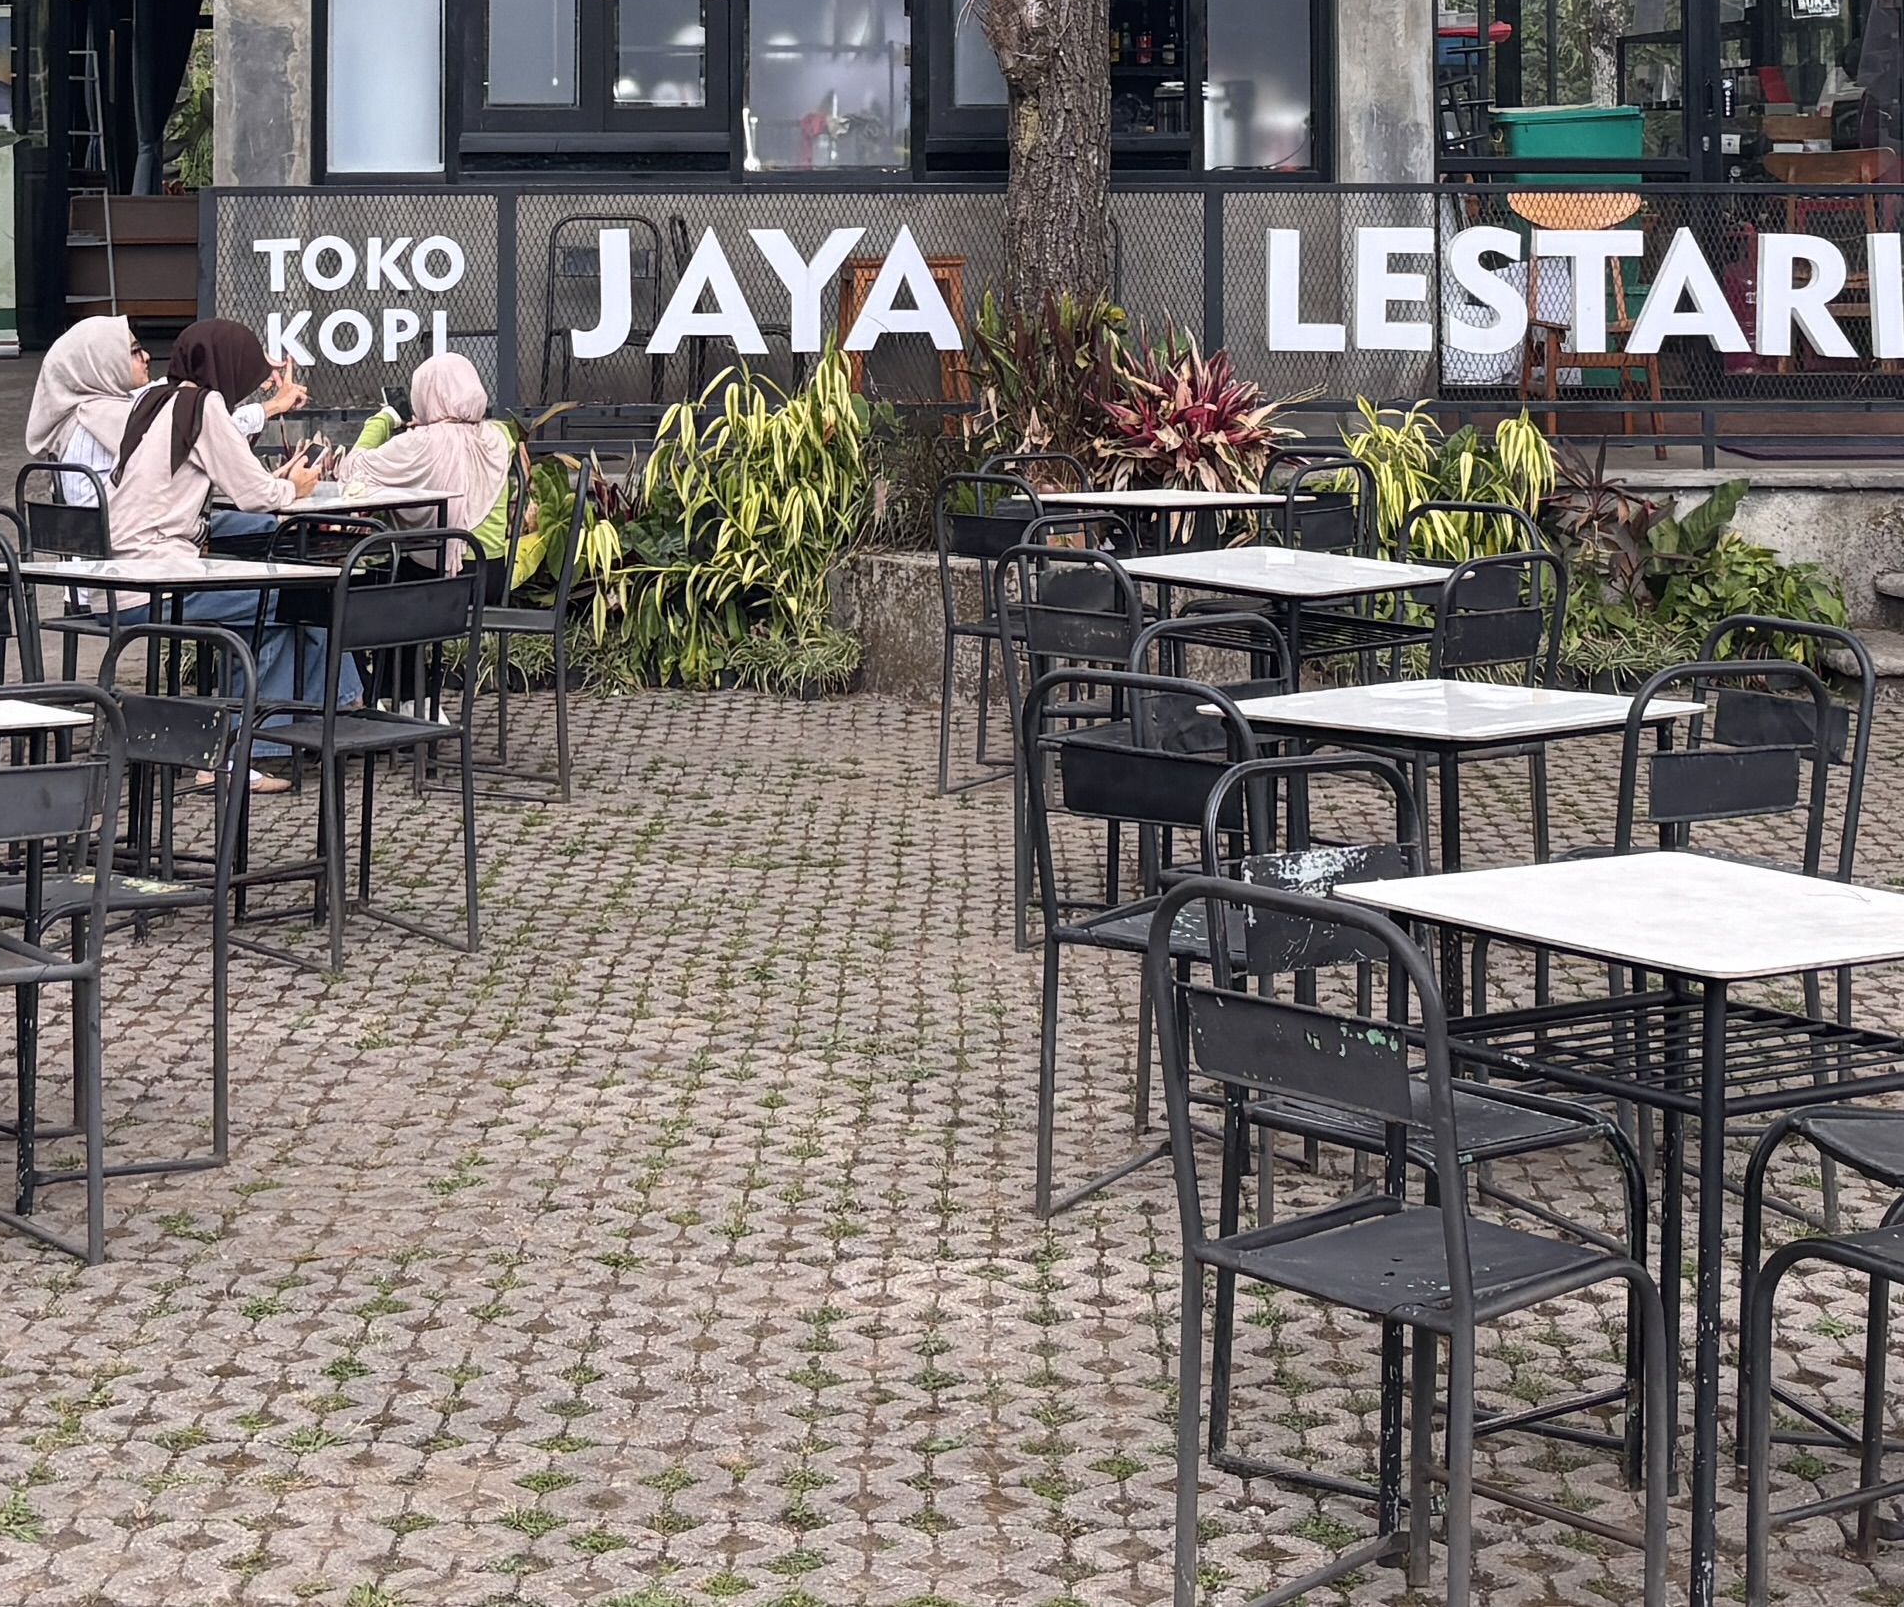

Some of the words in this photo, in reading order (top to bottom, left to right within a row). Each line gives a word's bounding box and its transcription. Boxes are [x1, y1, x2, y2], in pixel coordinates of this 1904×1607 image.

[253, 235, 465, 292] TOKO
[570, 225, 963, 359] JAYA
[267, 308, 448, 366] KOPI
